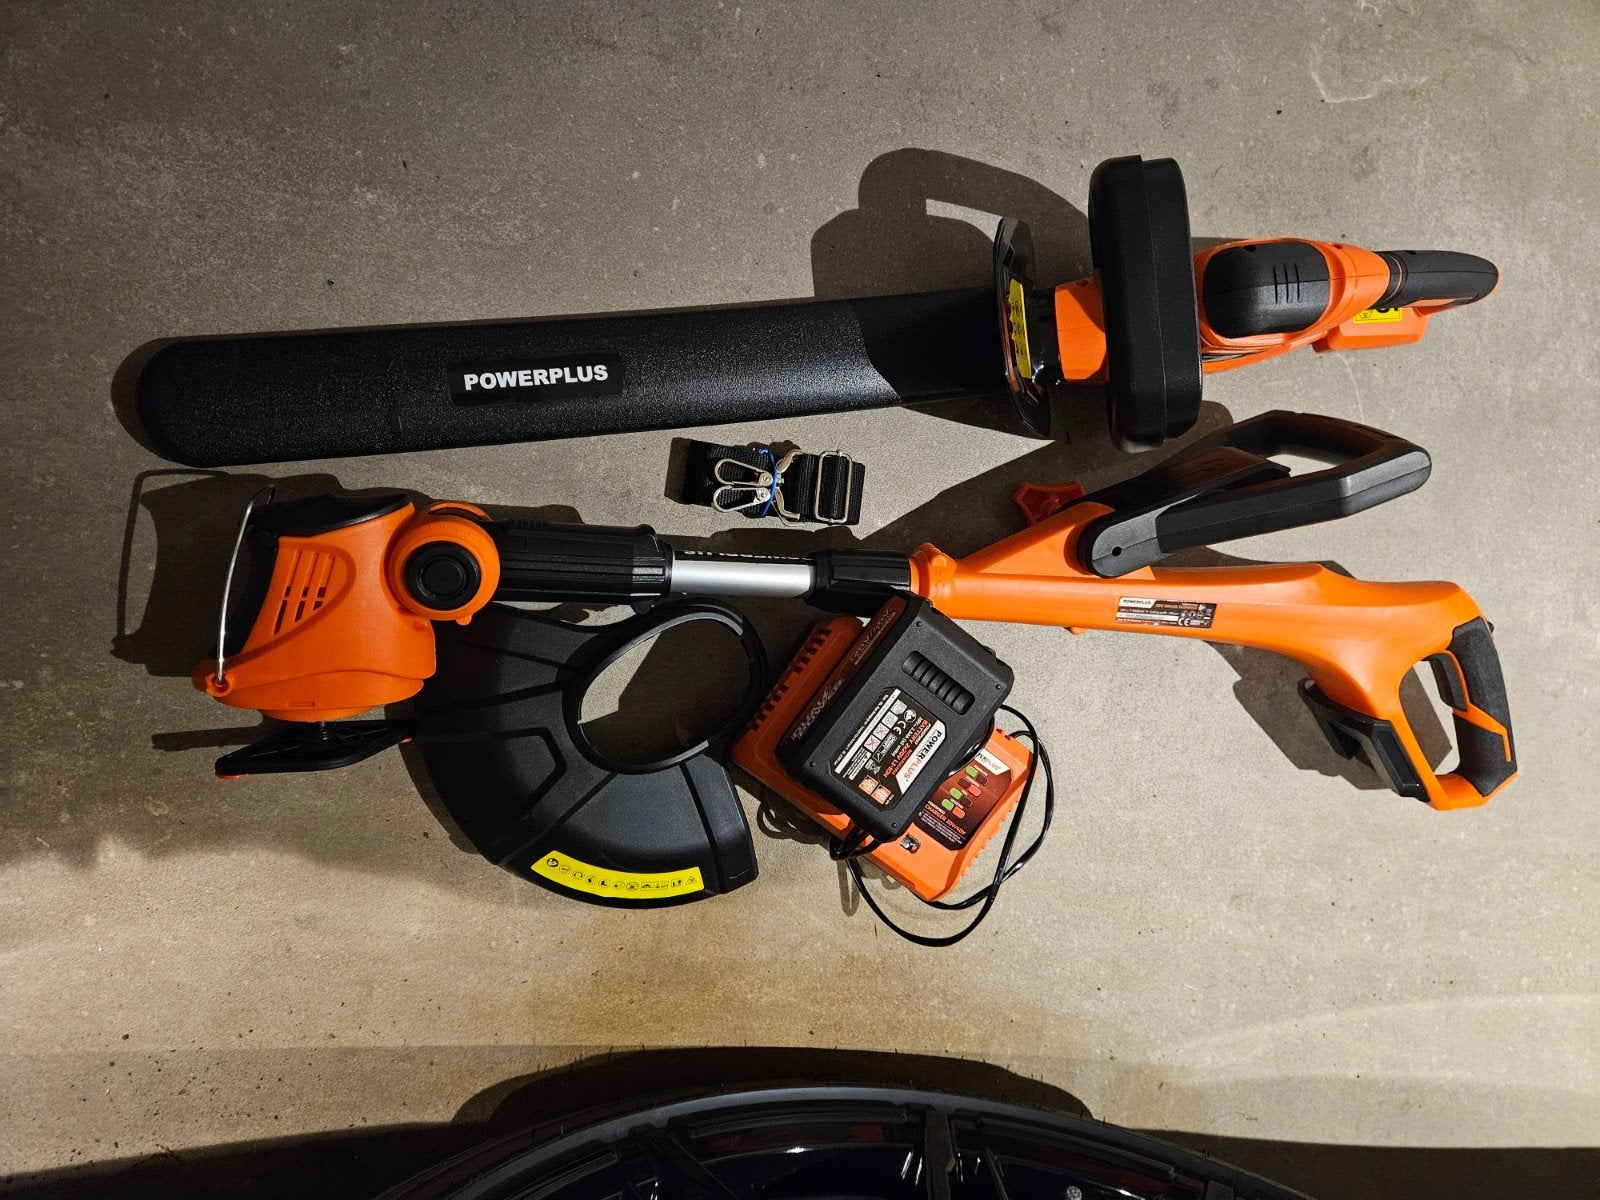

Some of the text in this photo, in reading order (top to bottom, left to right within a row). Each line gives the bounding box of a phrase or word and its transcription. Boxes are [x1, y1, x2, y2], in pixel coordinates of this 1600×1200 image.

[464, 364, 609, 391] POWERPLUS
[892, 719, 907, 734] CE
[907, 718, 928, 744] BATTERY
[902, 729, 942, 780] POWERPLUS
[923, 803, 946, 821] CHARGER
